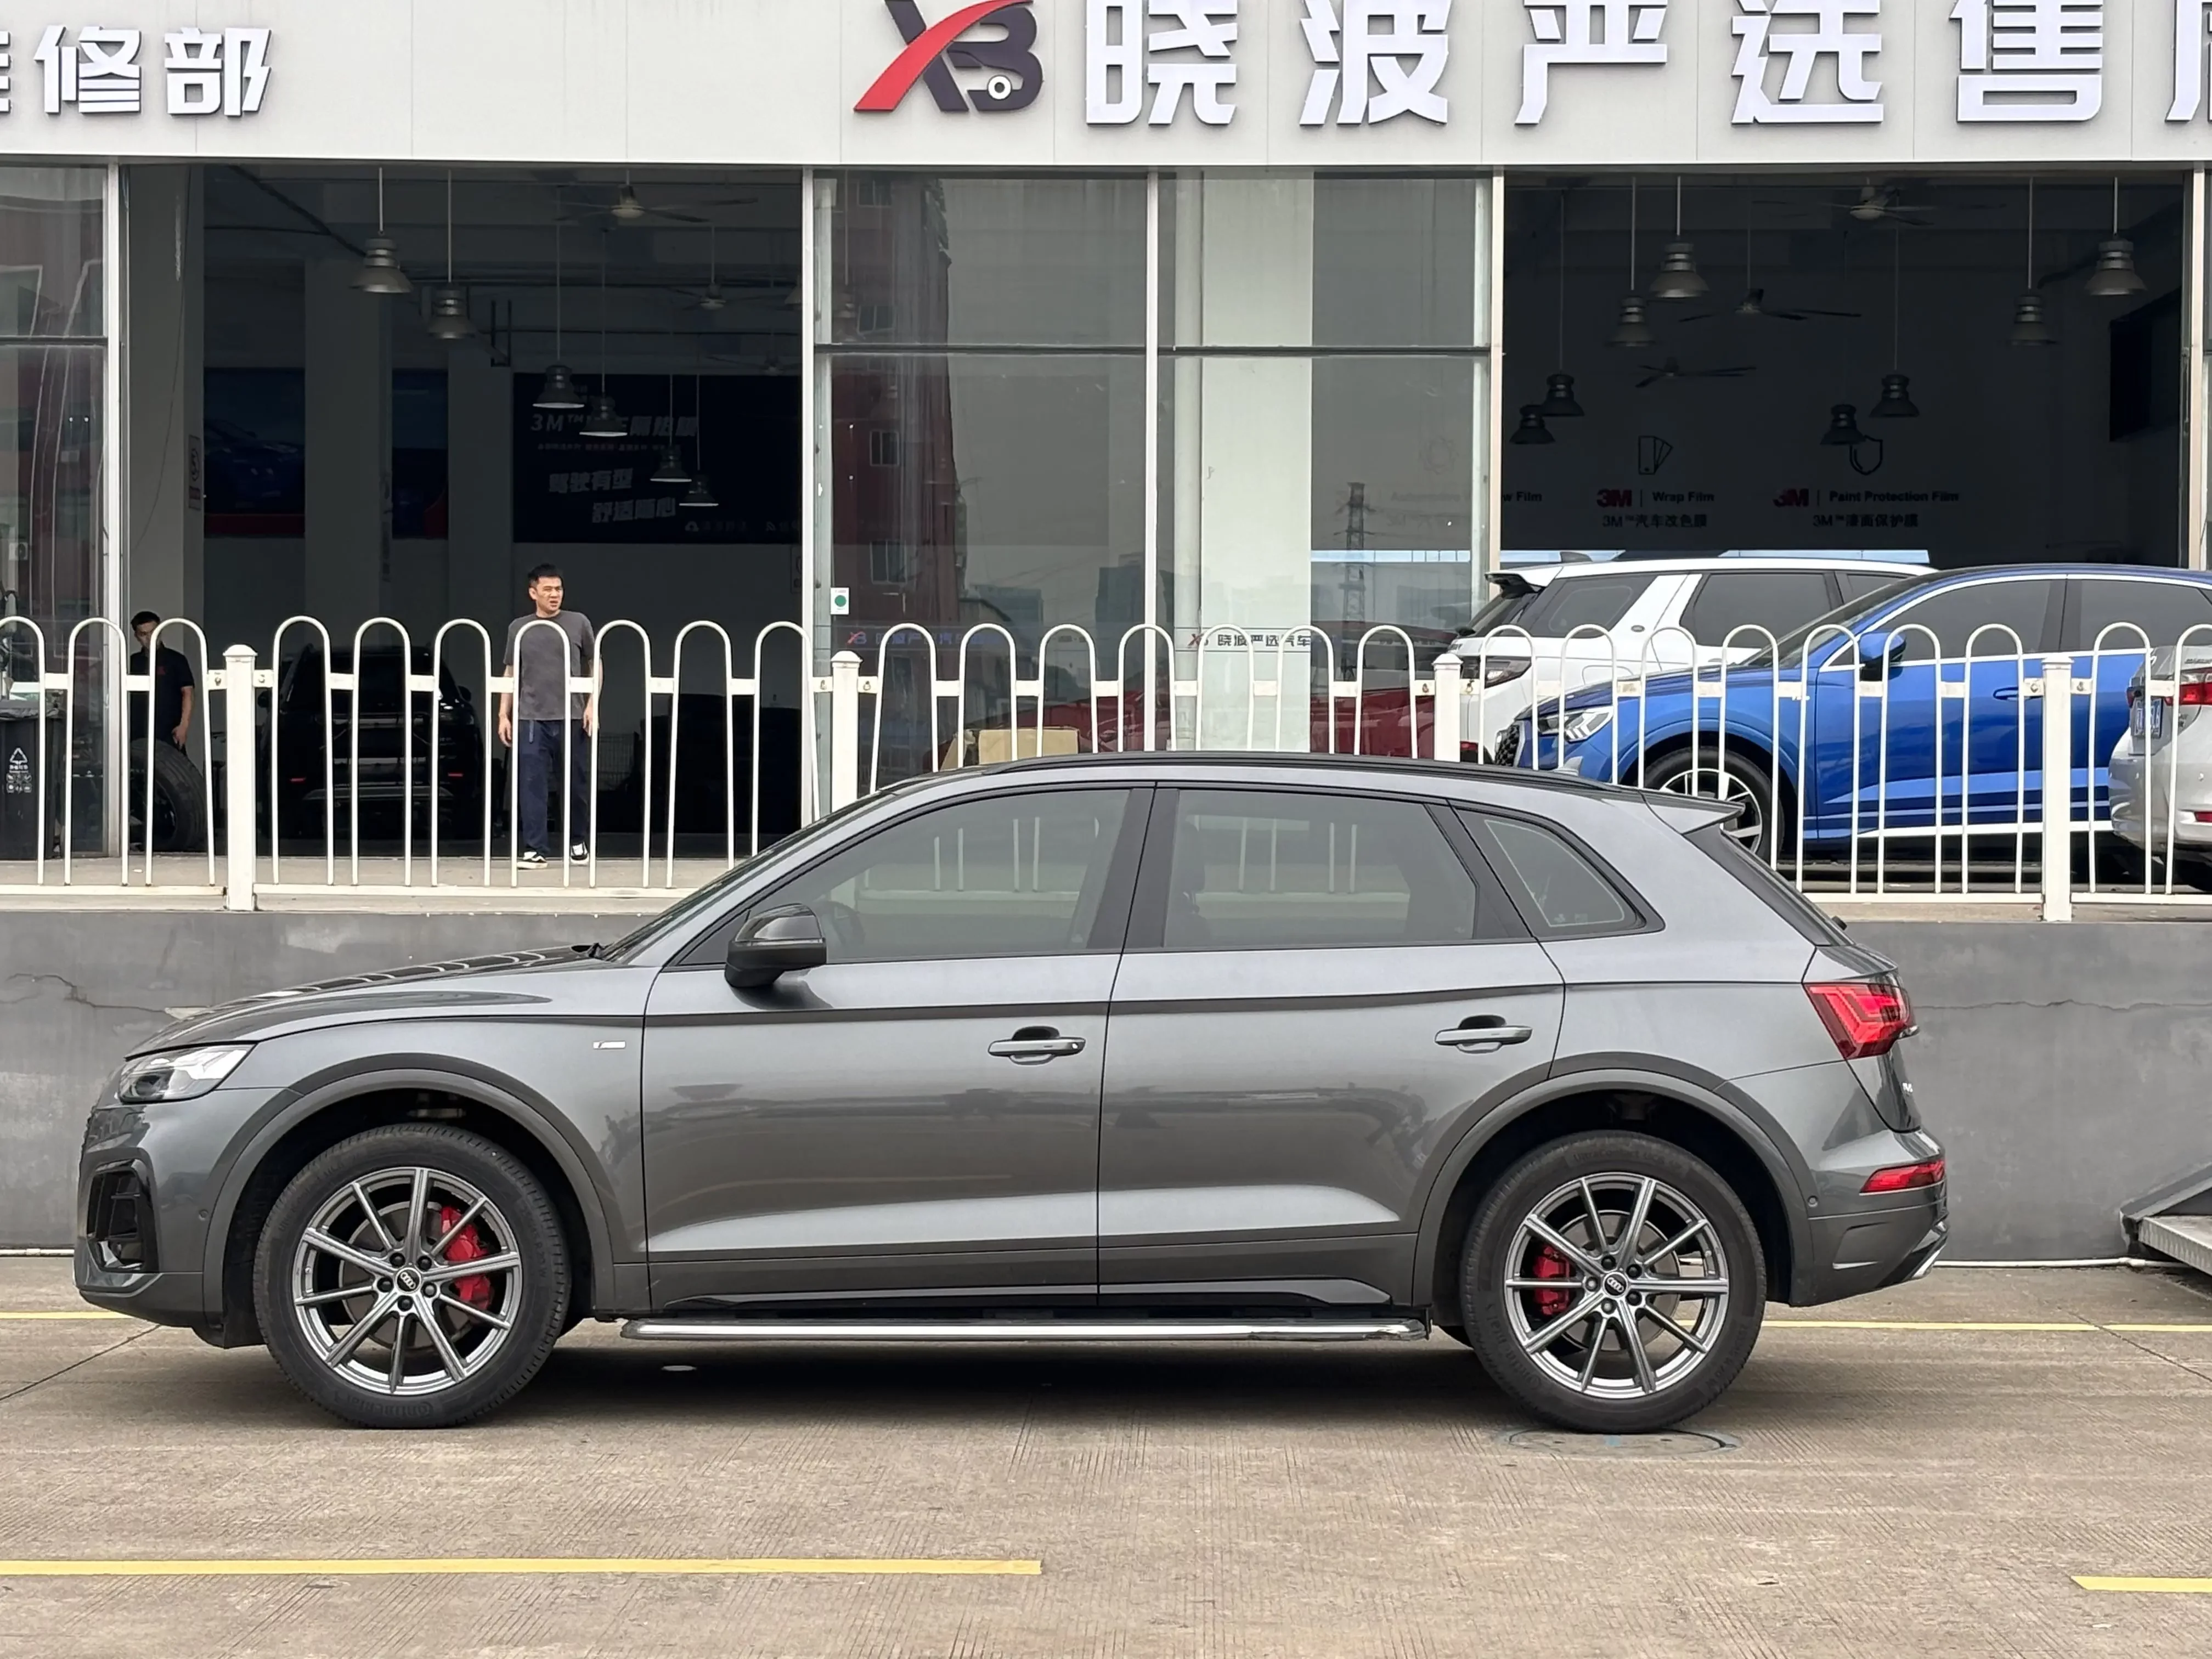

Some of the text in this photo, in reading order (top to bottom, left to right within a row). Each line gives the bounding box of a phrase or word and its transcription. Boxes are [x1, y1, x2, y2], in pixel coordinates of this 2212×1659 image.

[0, 25, 272, 117] 修部
[1086, 0, 2212, 126] 晓波严选售
[1516, 492, 1542, 502] Film
[1596, 488, 1716, 507] 3M Wrap Film
[1773, 488, 1959, 507] 3M Paint Protection Film
